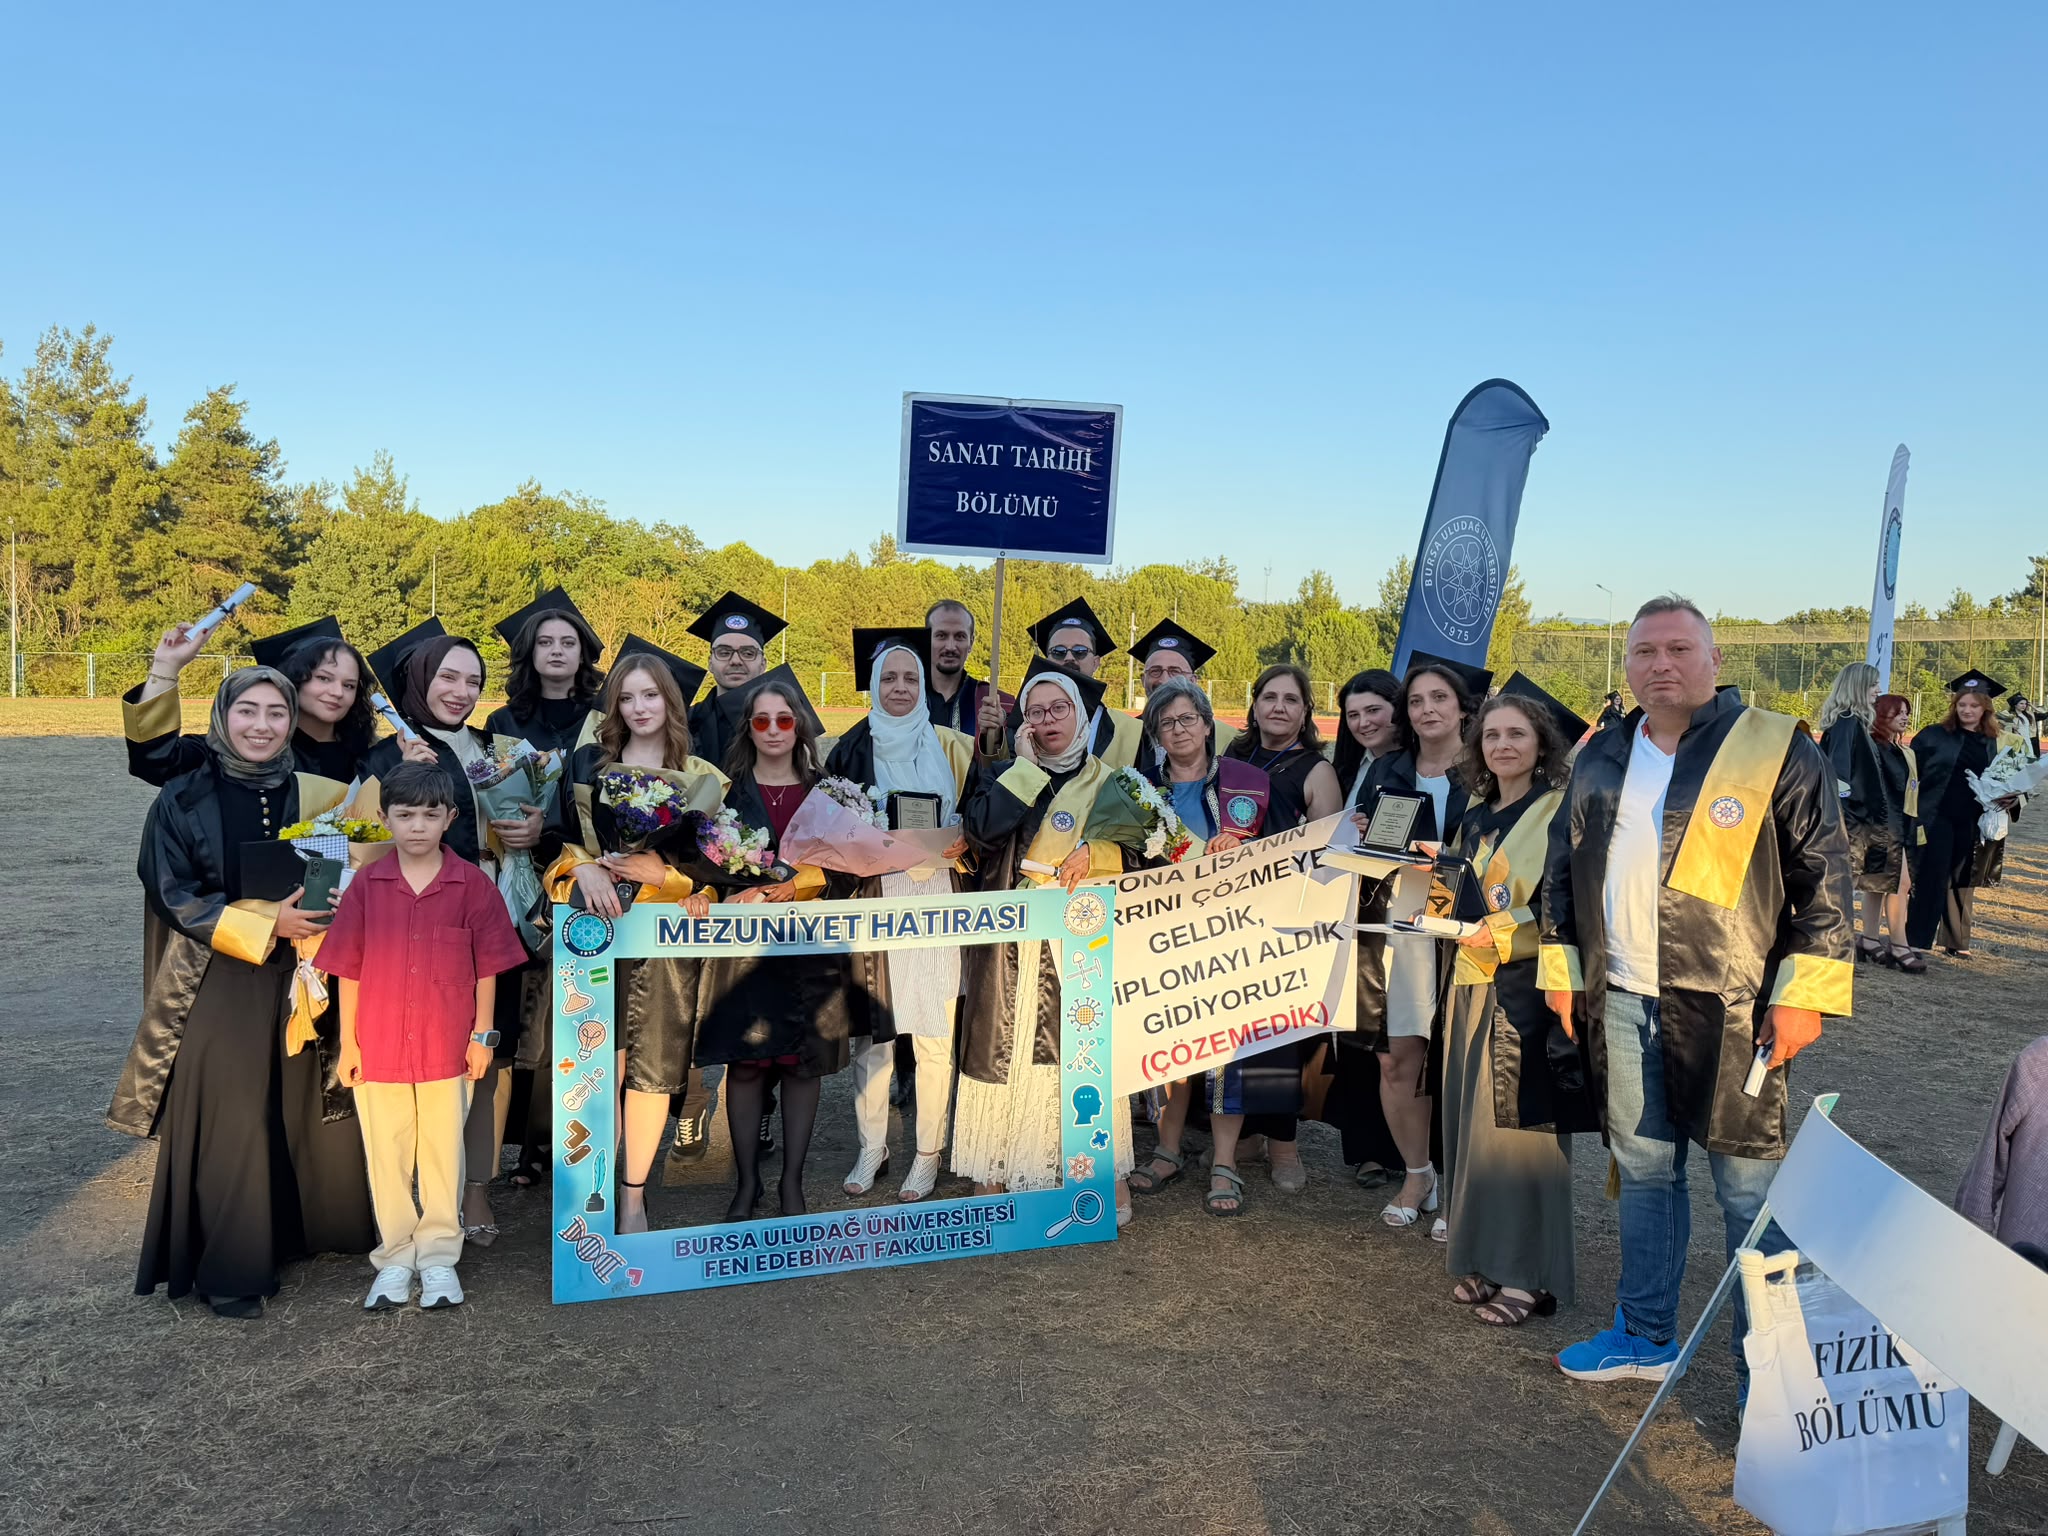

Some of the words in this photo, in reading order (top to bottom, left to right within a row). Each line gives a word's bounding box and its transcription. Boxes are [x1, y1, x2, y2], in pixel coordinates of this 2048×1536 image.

[928, 441, 1004, 466] SANAT
[1010, 445, 1092, 472] TARİHİ
[955, 491, 1059, 518] BÖLÜMÜ
[1425, 540, 1442, 587] BURSA
[1441, 520, 1481, 542] ULUDAĞ
[1442, 621, 1470, 642] 1975
[1191, 846, 1328, 910] ÇÖZMEYE
[656, 909, 863, 946] MEZUNİYET
[870, 903, 1028, 939] HATIRASI
[1148, 905, 1265, 955] GELDİK,
[1112, 946, 1251, 1007] İPLOMAYI
[1258, 919, 1345, 964] ALDIK
[1143, 967, 1310, 1035] GİDİYORUZ!
[1141, 1001, 1330, 1082] (ÇÖZEMEDİK)
[674, 1231, 758, 1258] BURSA
[763, 1217, 862, 1248] ULUDAĞ
[866, 1199, 1015, 1237] ÜNİVERSİTESİ
[704, 1256, 749, 1279] FEN
[755, 1241, 869, 1273] EDEBİYAT
[874, 1224, 992, 1262] FAKÜLTESİ
[1812, 1324, 1913, 1379] FİZİK
[1794, 1382, 1946, 1453] BÖLÜMÜ
